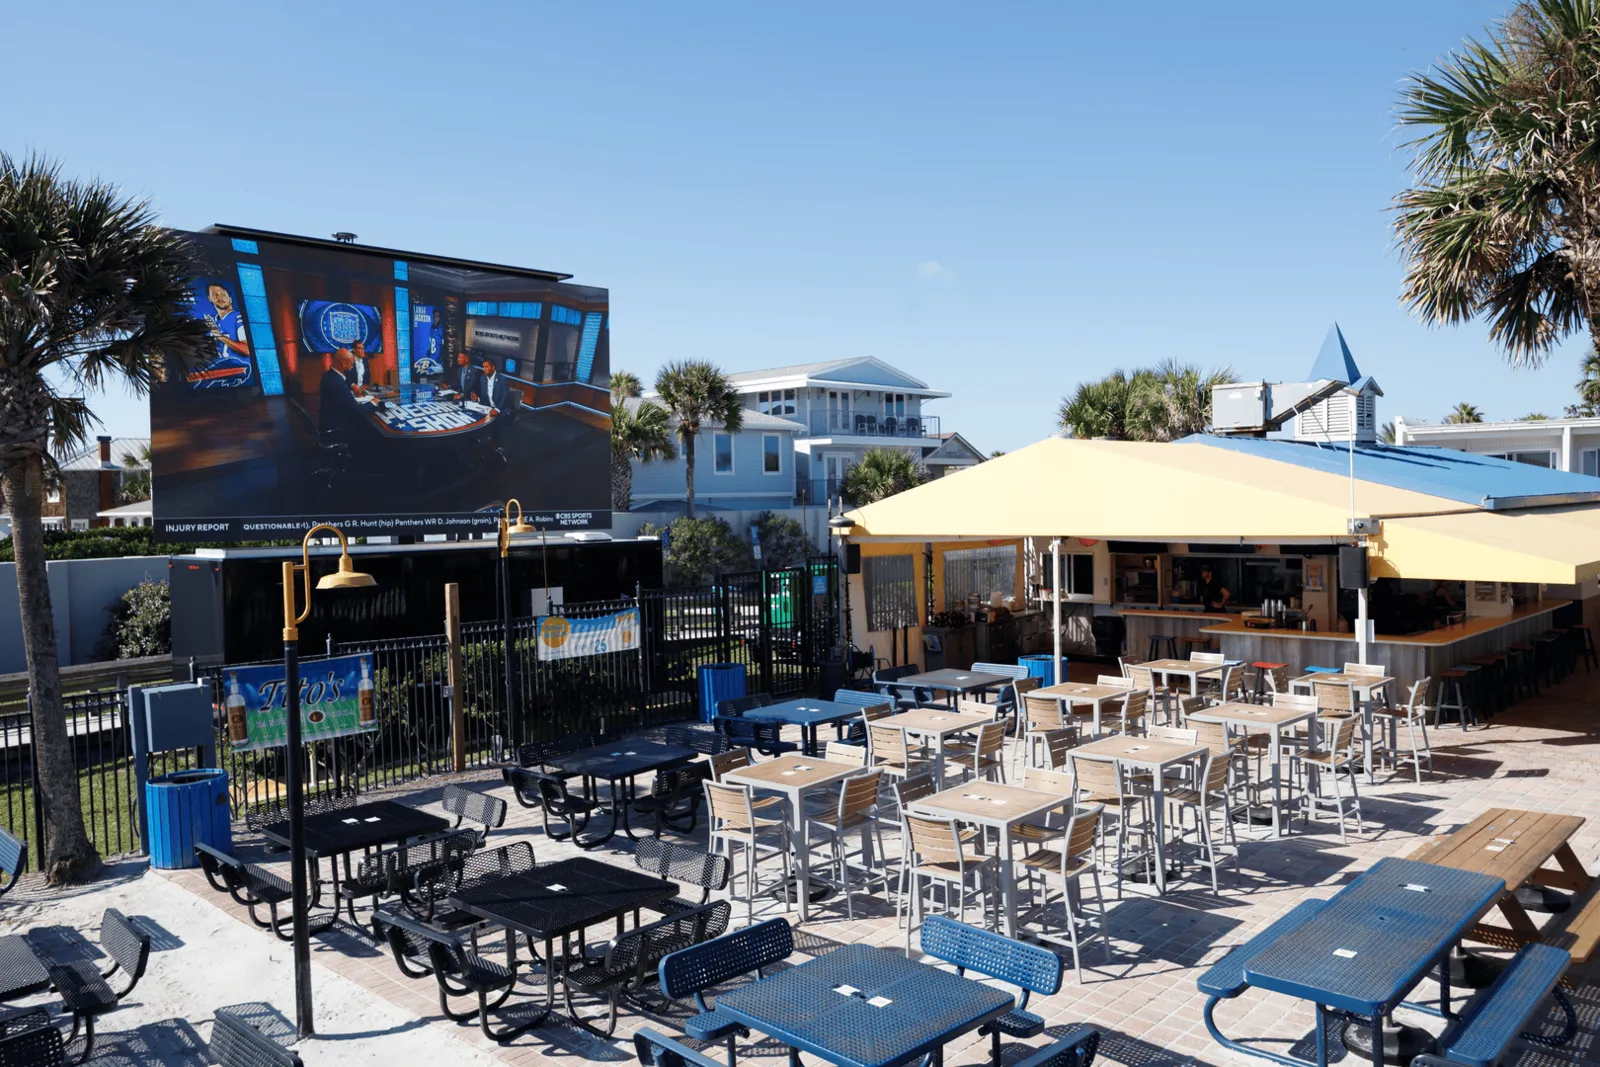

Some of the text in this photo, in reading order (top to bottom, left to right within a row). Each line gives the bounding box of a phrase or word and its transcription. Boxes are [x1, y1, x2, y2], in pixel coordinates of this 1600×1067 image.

[165, 523, 230, 532] INJURY REPORT
[243, 522, 300, 530] QUESTIONABLE
[360, 519, 377, 527] Hunt
[378, 519, 394, 528] (hip)
[395, 518, 424, 526] Panthers
